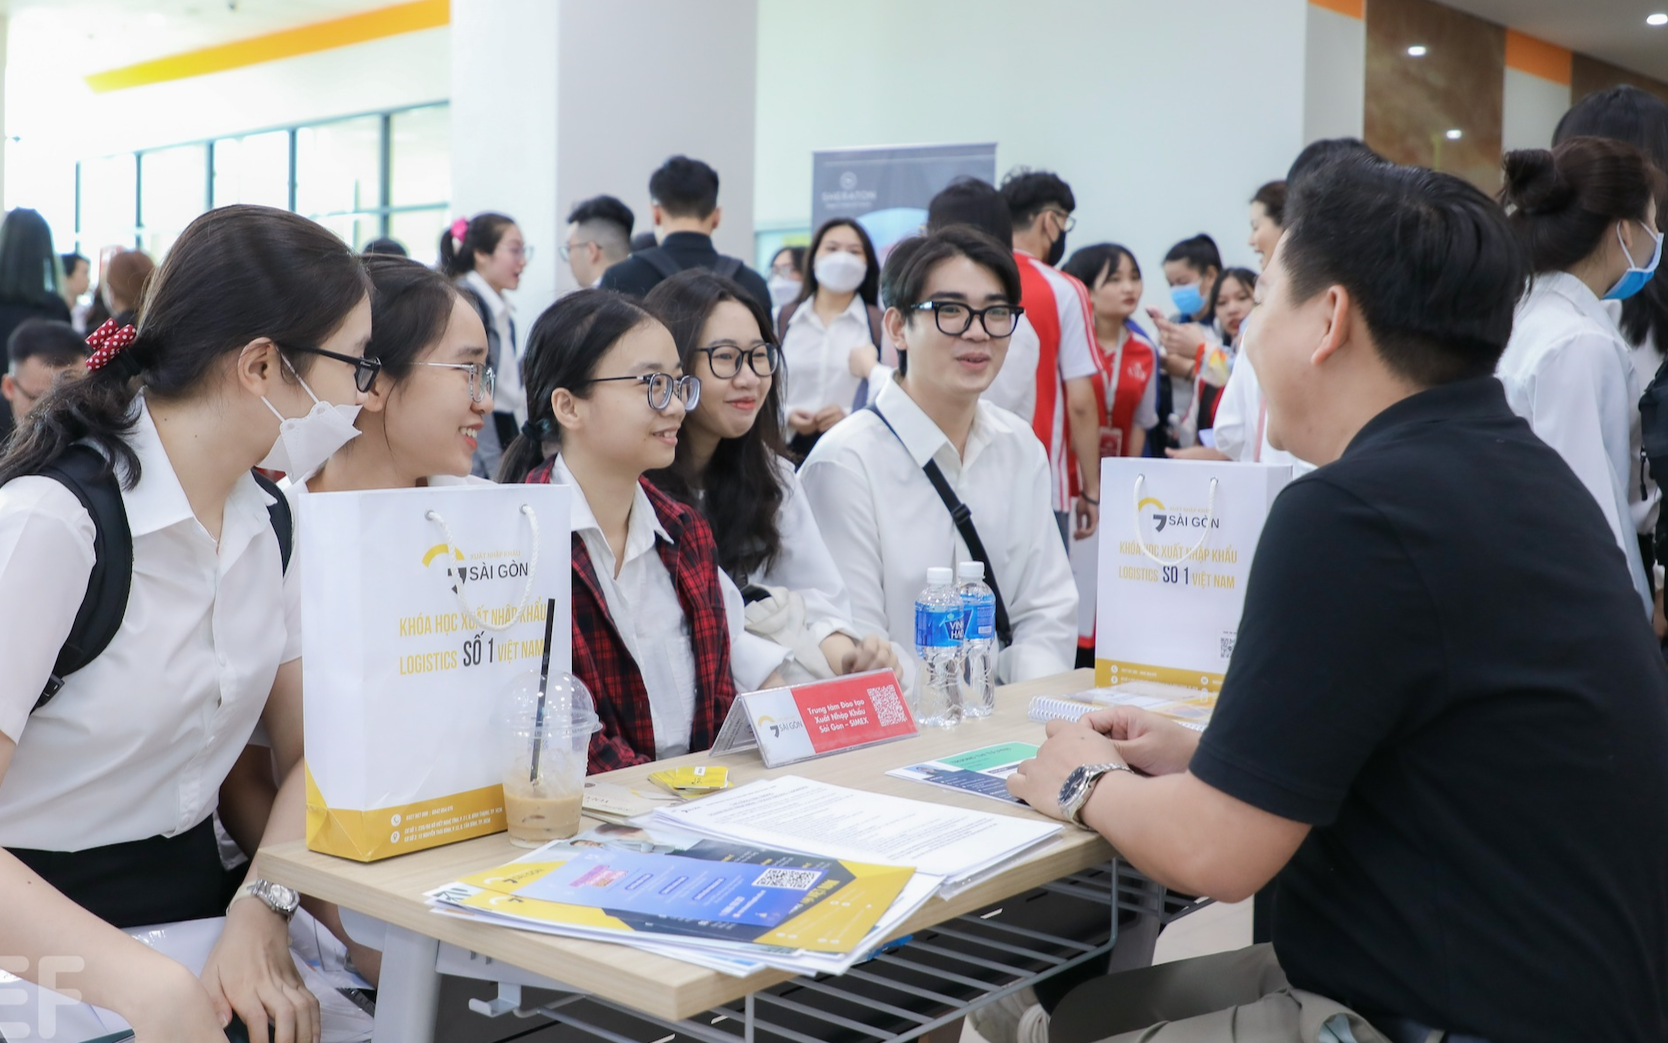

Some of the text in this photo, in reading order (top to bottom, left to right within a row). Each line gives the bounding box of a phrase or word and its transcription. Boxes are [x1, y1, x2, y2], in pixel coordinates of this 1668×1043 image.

[1168, 513, 1220, 529] SÀI GÒN
[1161, 543, 1183, 559] XUẤT
[1211, 544, 1237, 563] KHẨU
[469, 559, 529, 581] SÀI GÒN
[1119, 565, 1159, 582] LOGISTICS
[1183, 566, 1189, 585] 1
[1192, 570, 1211, 589] VIỆT
[1213, 574, 1235, 589] NAM
[399, 612, 432, 637] KHÓA
[435, 613, 458, 636] HỌC
[399, 631, 544, 676] LOGISTICS SỐ 1 VIỆT NAM
[807, 706, 828, 716] Trung
[827, 703, 840, 712] tâm
[853, 699, 865, 708] tạo
[814, 707, 866, 724] Xuất Nhập Khẩu
[819, 723, 831, 734] Sài
[830, 722, 845, 732] Gòn
[849, 716, 870, 728] SIMEX
